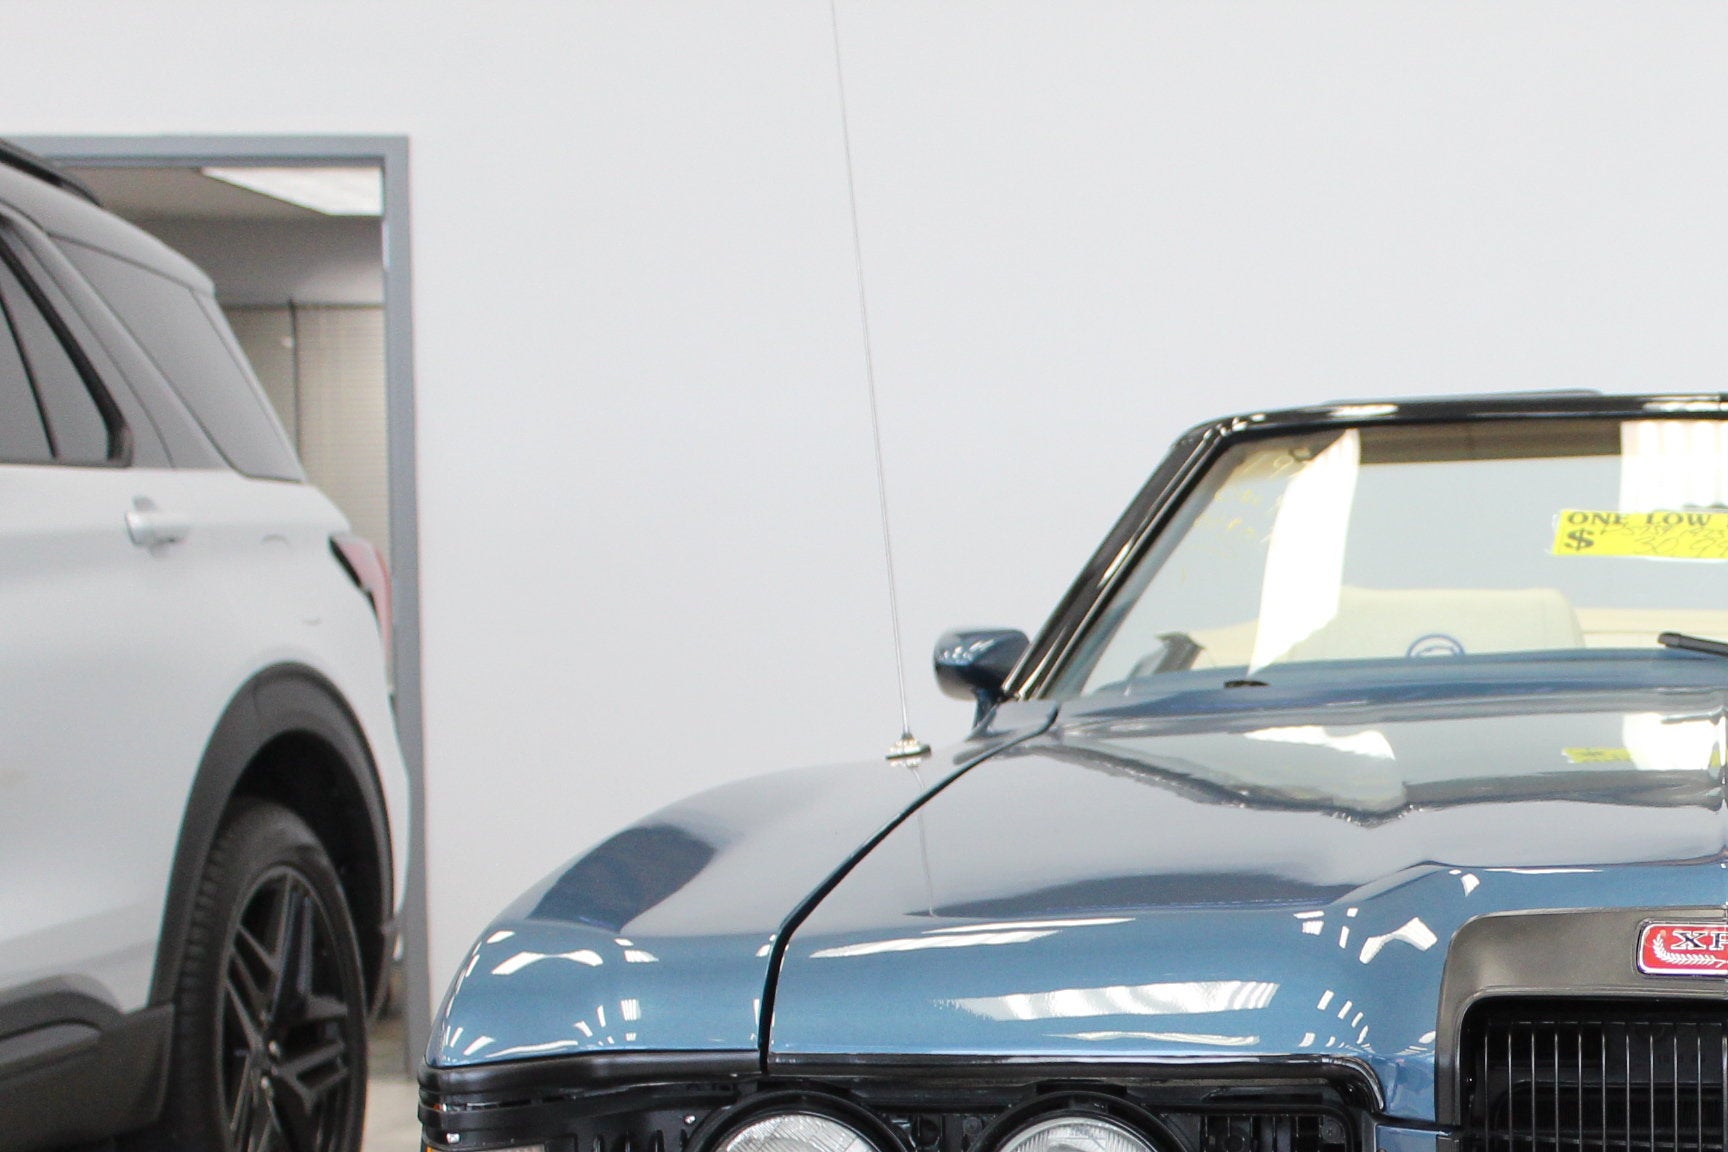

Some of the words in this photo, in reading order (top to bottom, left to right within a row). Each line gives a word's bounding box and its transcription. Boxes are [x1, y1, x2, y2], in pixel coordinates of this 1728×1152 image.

[1566, 510, 1629, 527] ONE
[1645, 511, 1712, 528] LOW
[1563, 526, 1597, 551] $
